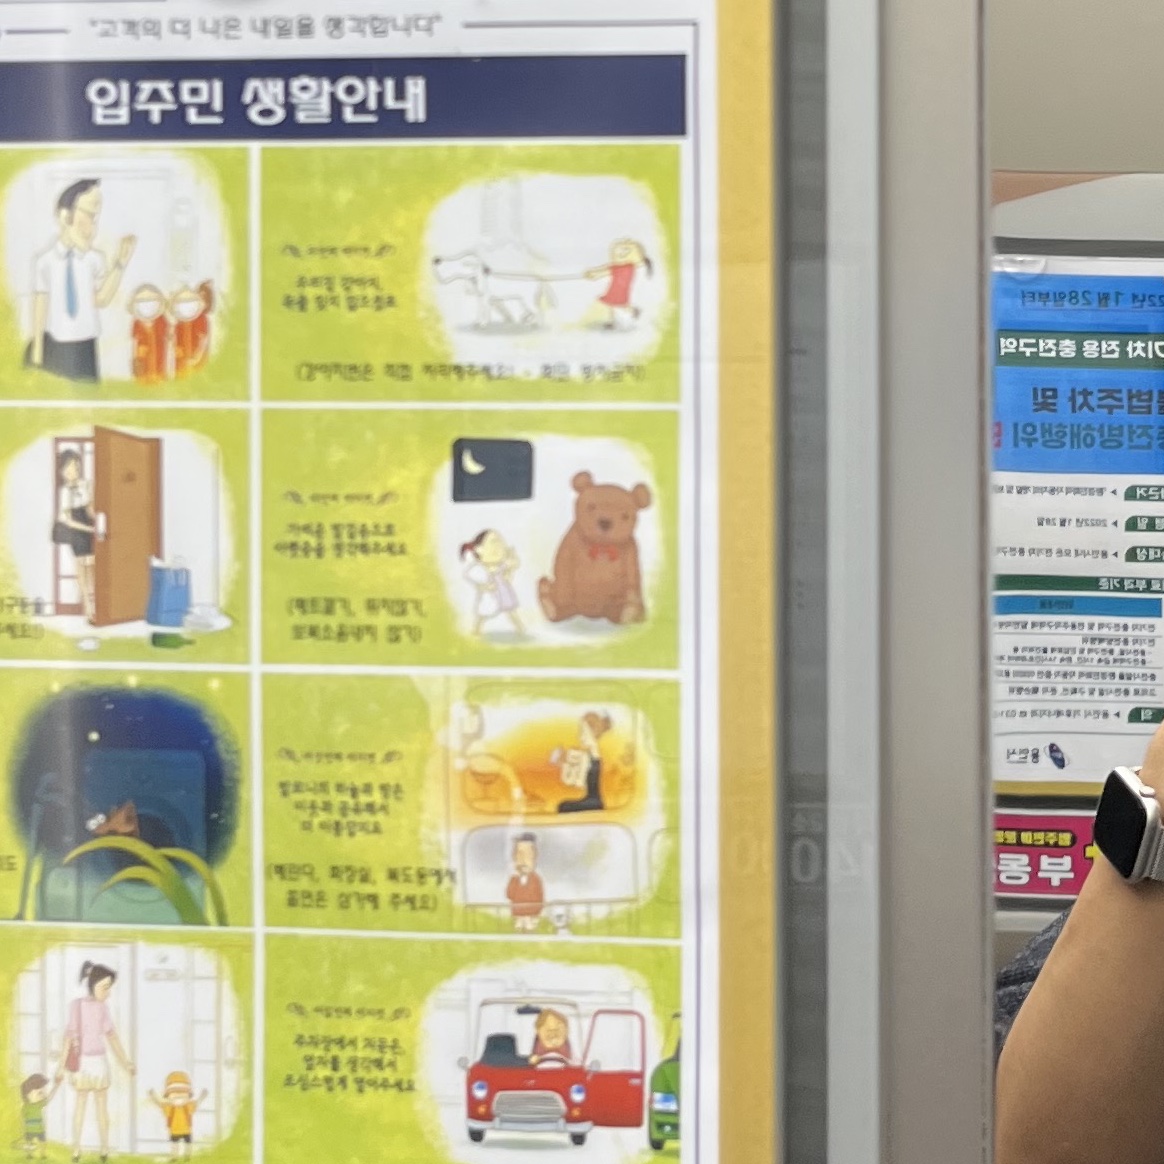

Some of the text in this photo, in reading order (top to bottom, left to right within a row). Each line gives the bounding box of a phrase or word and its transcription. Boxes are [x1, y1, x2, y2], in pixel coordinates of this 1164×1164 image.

[90, 13, 443, 40] "고객의 더 나은 내일을 생각합니다"
[86, 75, 427, 126] 입주민 생활안내
